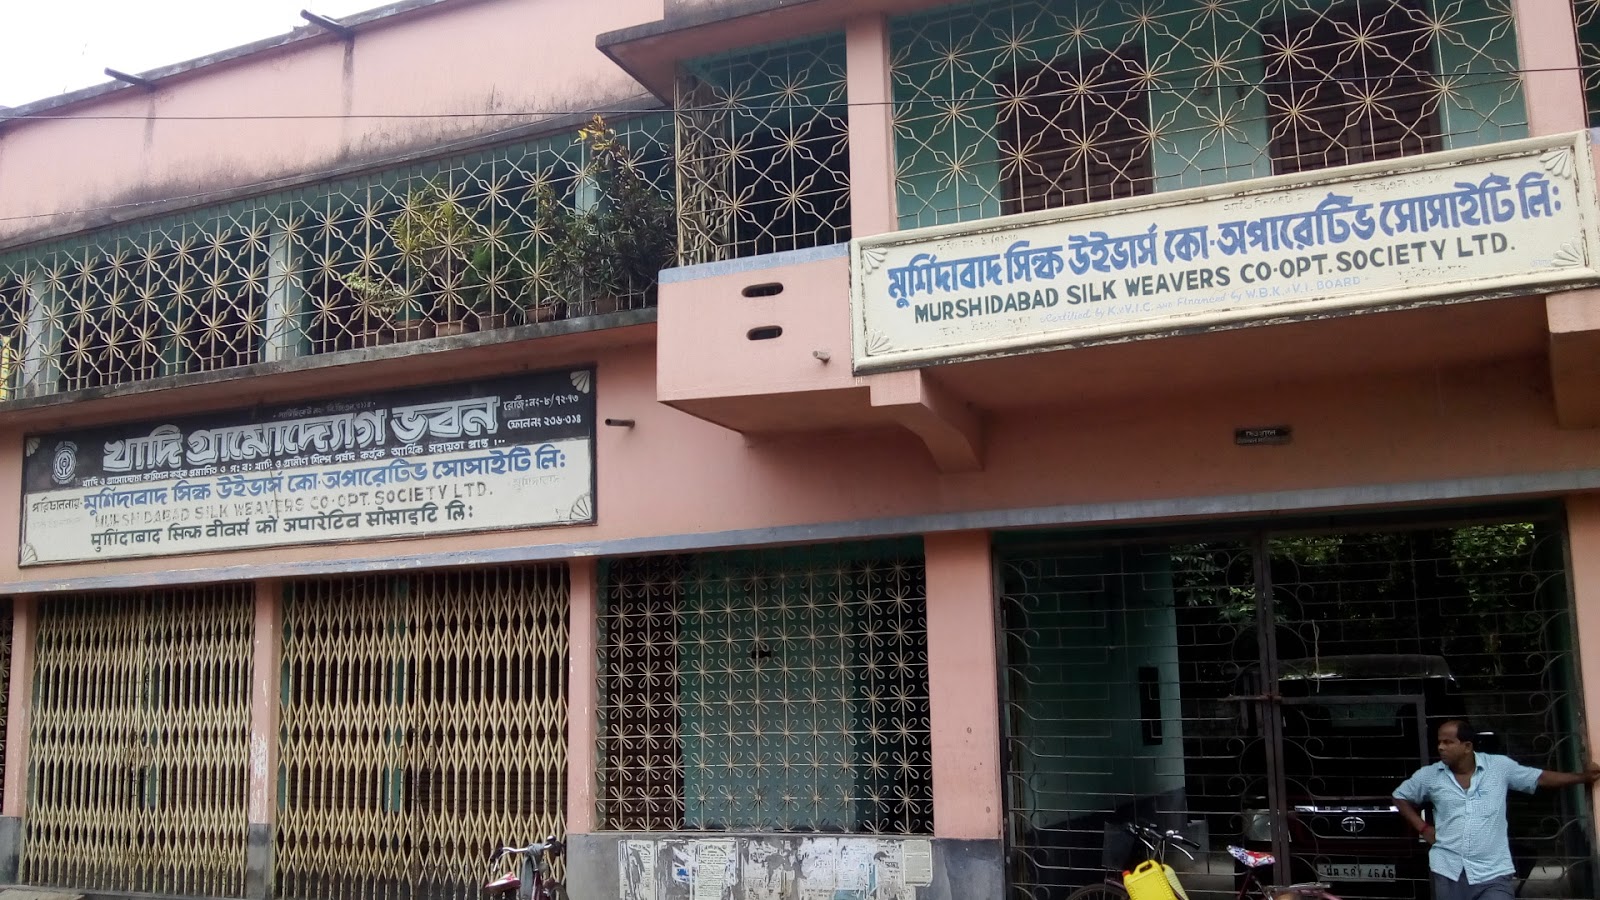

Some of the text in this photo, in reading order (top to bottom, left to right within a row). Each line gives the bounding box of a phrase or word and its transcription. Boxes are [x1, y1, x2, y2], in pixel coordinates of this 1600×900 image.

[887, 253, 1003, 309] মুর্শিদাবাদ
[1004, 240, 1065, 284] সিল্ক
[1068, 222, 1158, 276] উইভার্স
[1379, 172, 1515, 237] সোসাইটি
[914, 287, 1059, 324] MURSHIDABAD
[1066, 279, 1117, 305] SILK
[1124, 266, 1231, 298] WEAVERS
[1336, 238, 1447, 273] SOCIETY
[1456, 232, 1516, 259] LTD.
[1316, 276, 1362, 290] BOARD
[102, 424, 184, 473] খাদি
[390, 395, 501, 444] ভবন
[83, 486, 168, 516] মুর্শিদাবাদ
[216, 470, 285, 500] উইভার্স
[432, 446, 531, 480] সোসাইটি
[194, 503, 230, 520] SILK
[233, 497, 305, 517] WEAVERS
[374, 484, 448, 506] SOCIETY
[453, 481, 493, 499] LTD.
